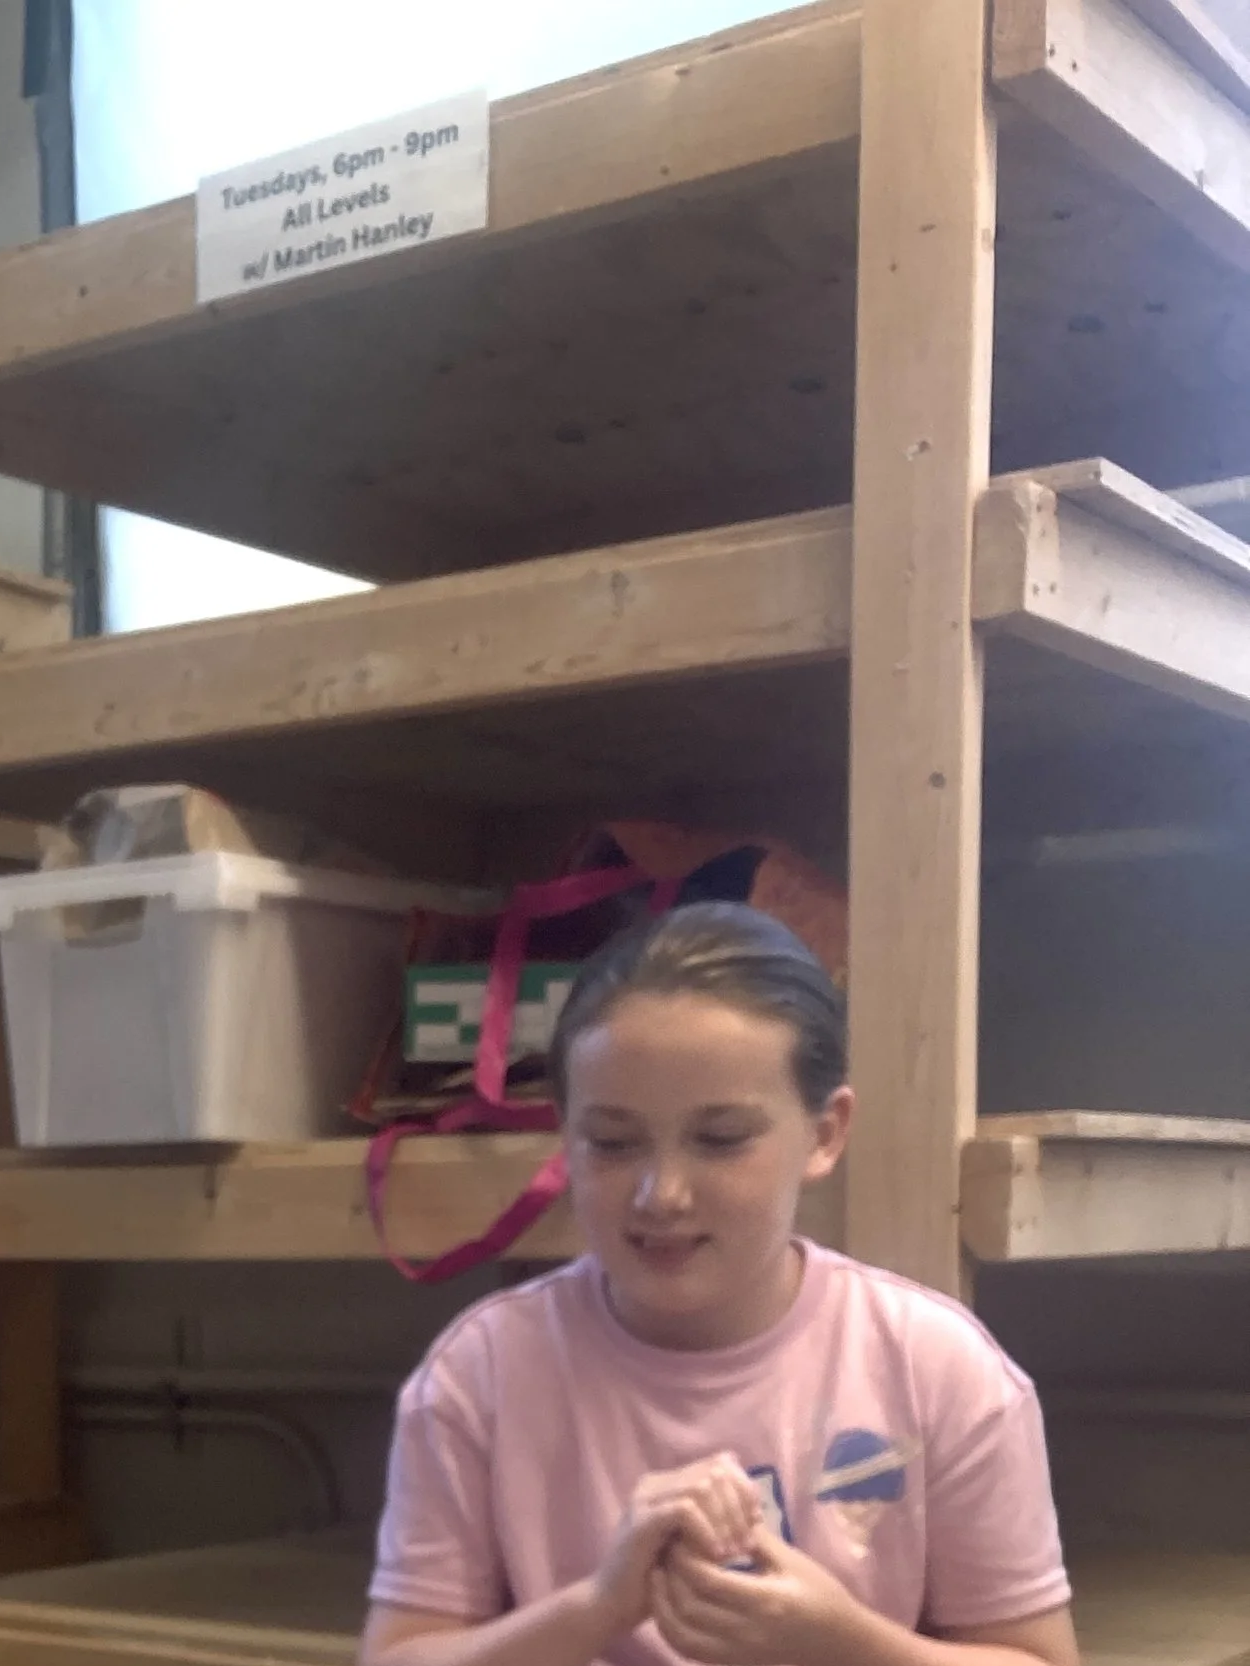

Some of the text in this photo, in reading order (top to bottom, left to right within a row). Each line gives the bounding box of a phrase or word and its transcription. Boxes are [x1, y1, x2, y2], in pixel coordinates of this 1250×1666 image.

[222, 169, 327, 210] Tuesdays,
[333, 146, 385, 178] 6pm
[405, 125, 459, 157] 9pm
[282, 182, 390, 232] All Levels
[273, 232, 347, 272] Martin
[352, 211, 434, 250] Hanley
